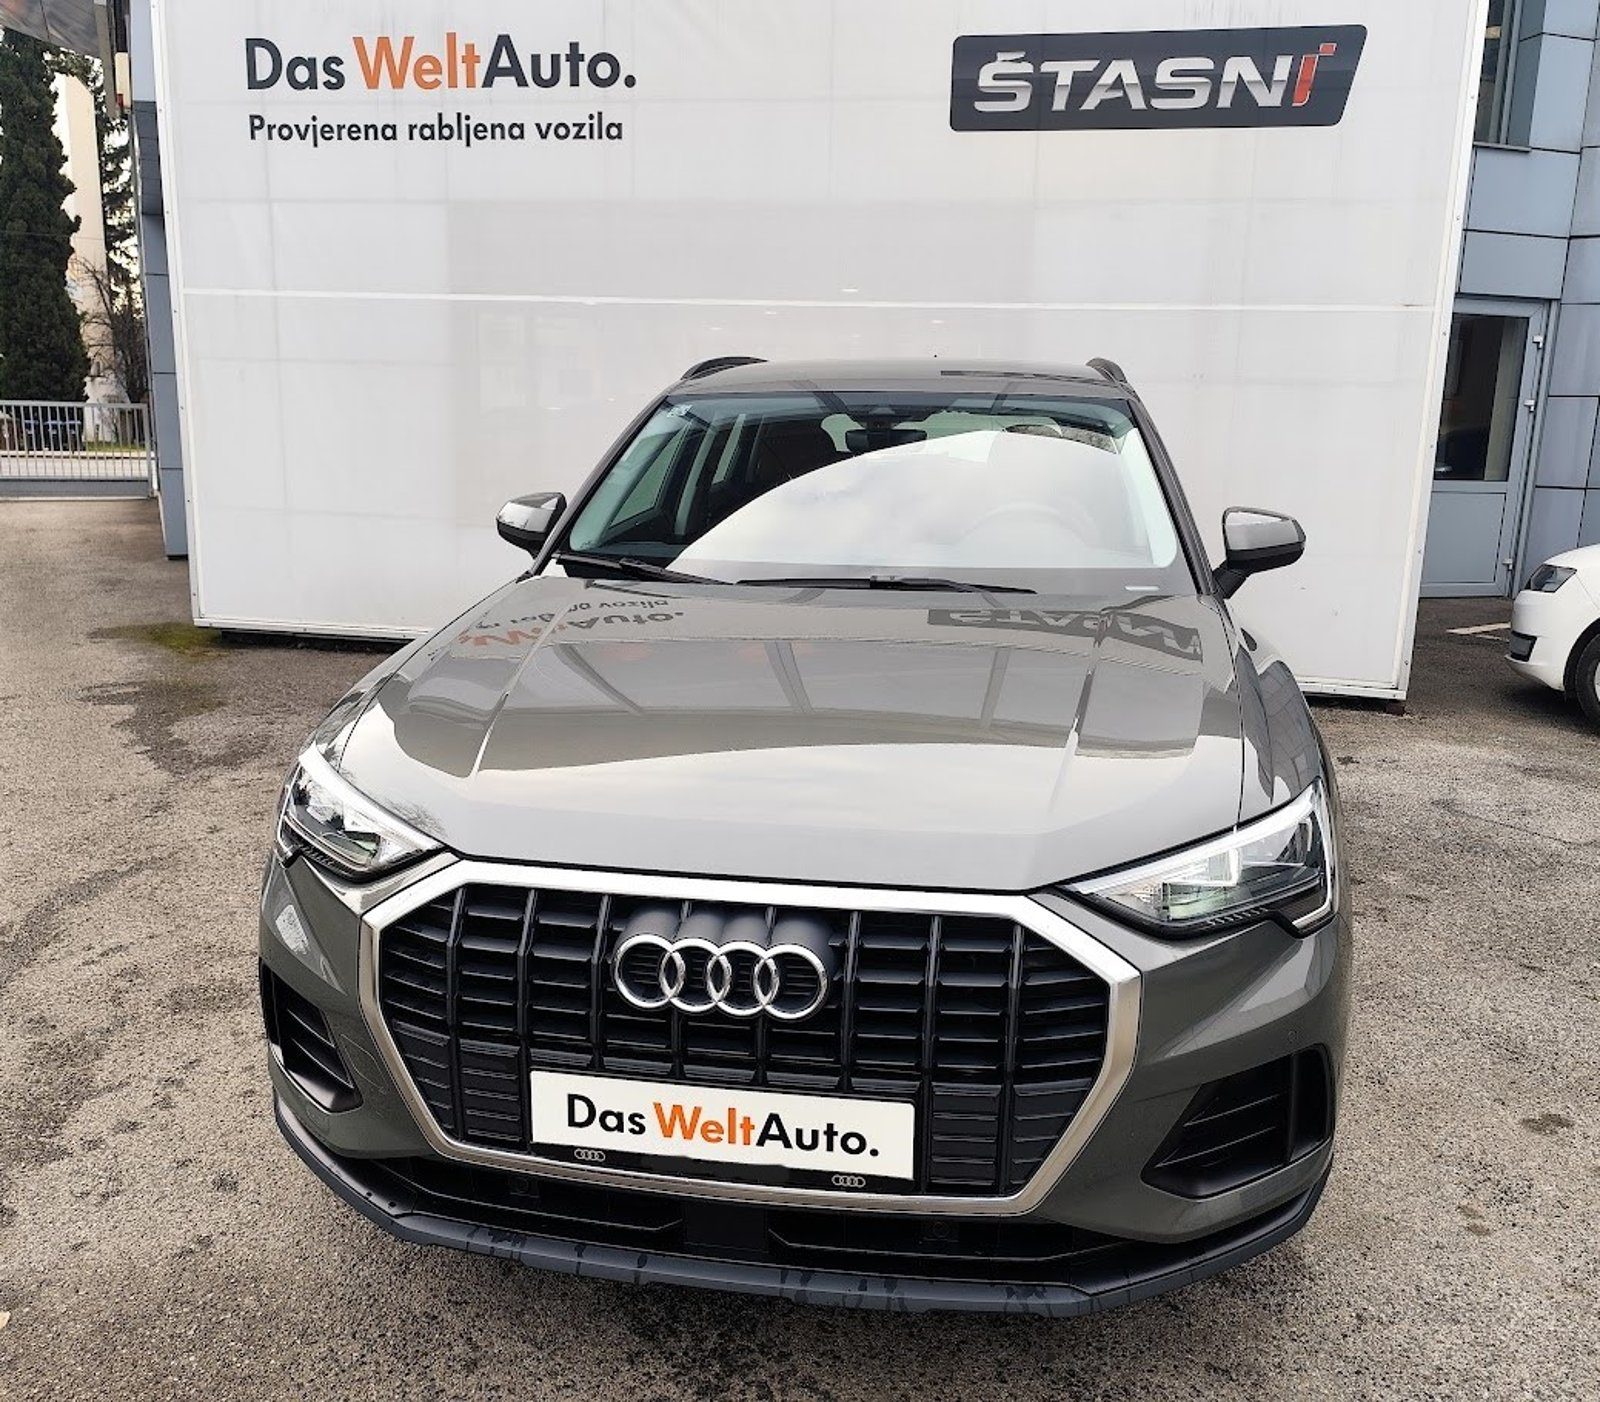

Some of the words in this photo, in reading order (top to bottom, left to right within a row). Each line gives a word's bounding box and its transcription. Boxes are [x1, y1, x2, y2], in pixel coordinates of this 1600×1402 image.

[246, 38, 345, 90] Das
[353, 33, 636, 89] WeltAuto.
[249, 114, 397, 147] Provjerena
[408, 112, 524, 147] rabljena
[535, 112, 623, 140] vozila
[567, 1093, 646, 1135] Das
[654, 1102, 879, 1157] WeltAuto.
